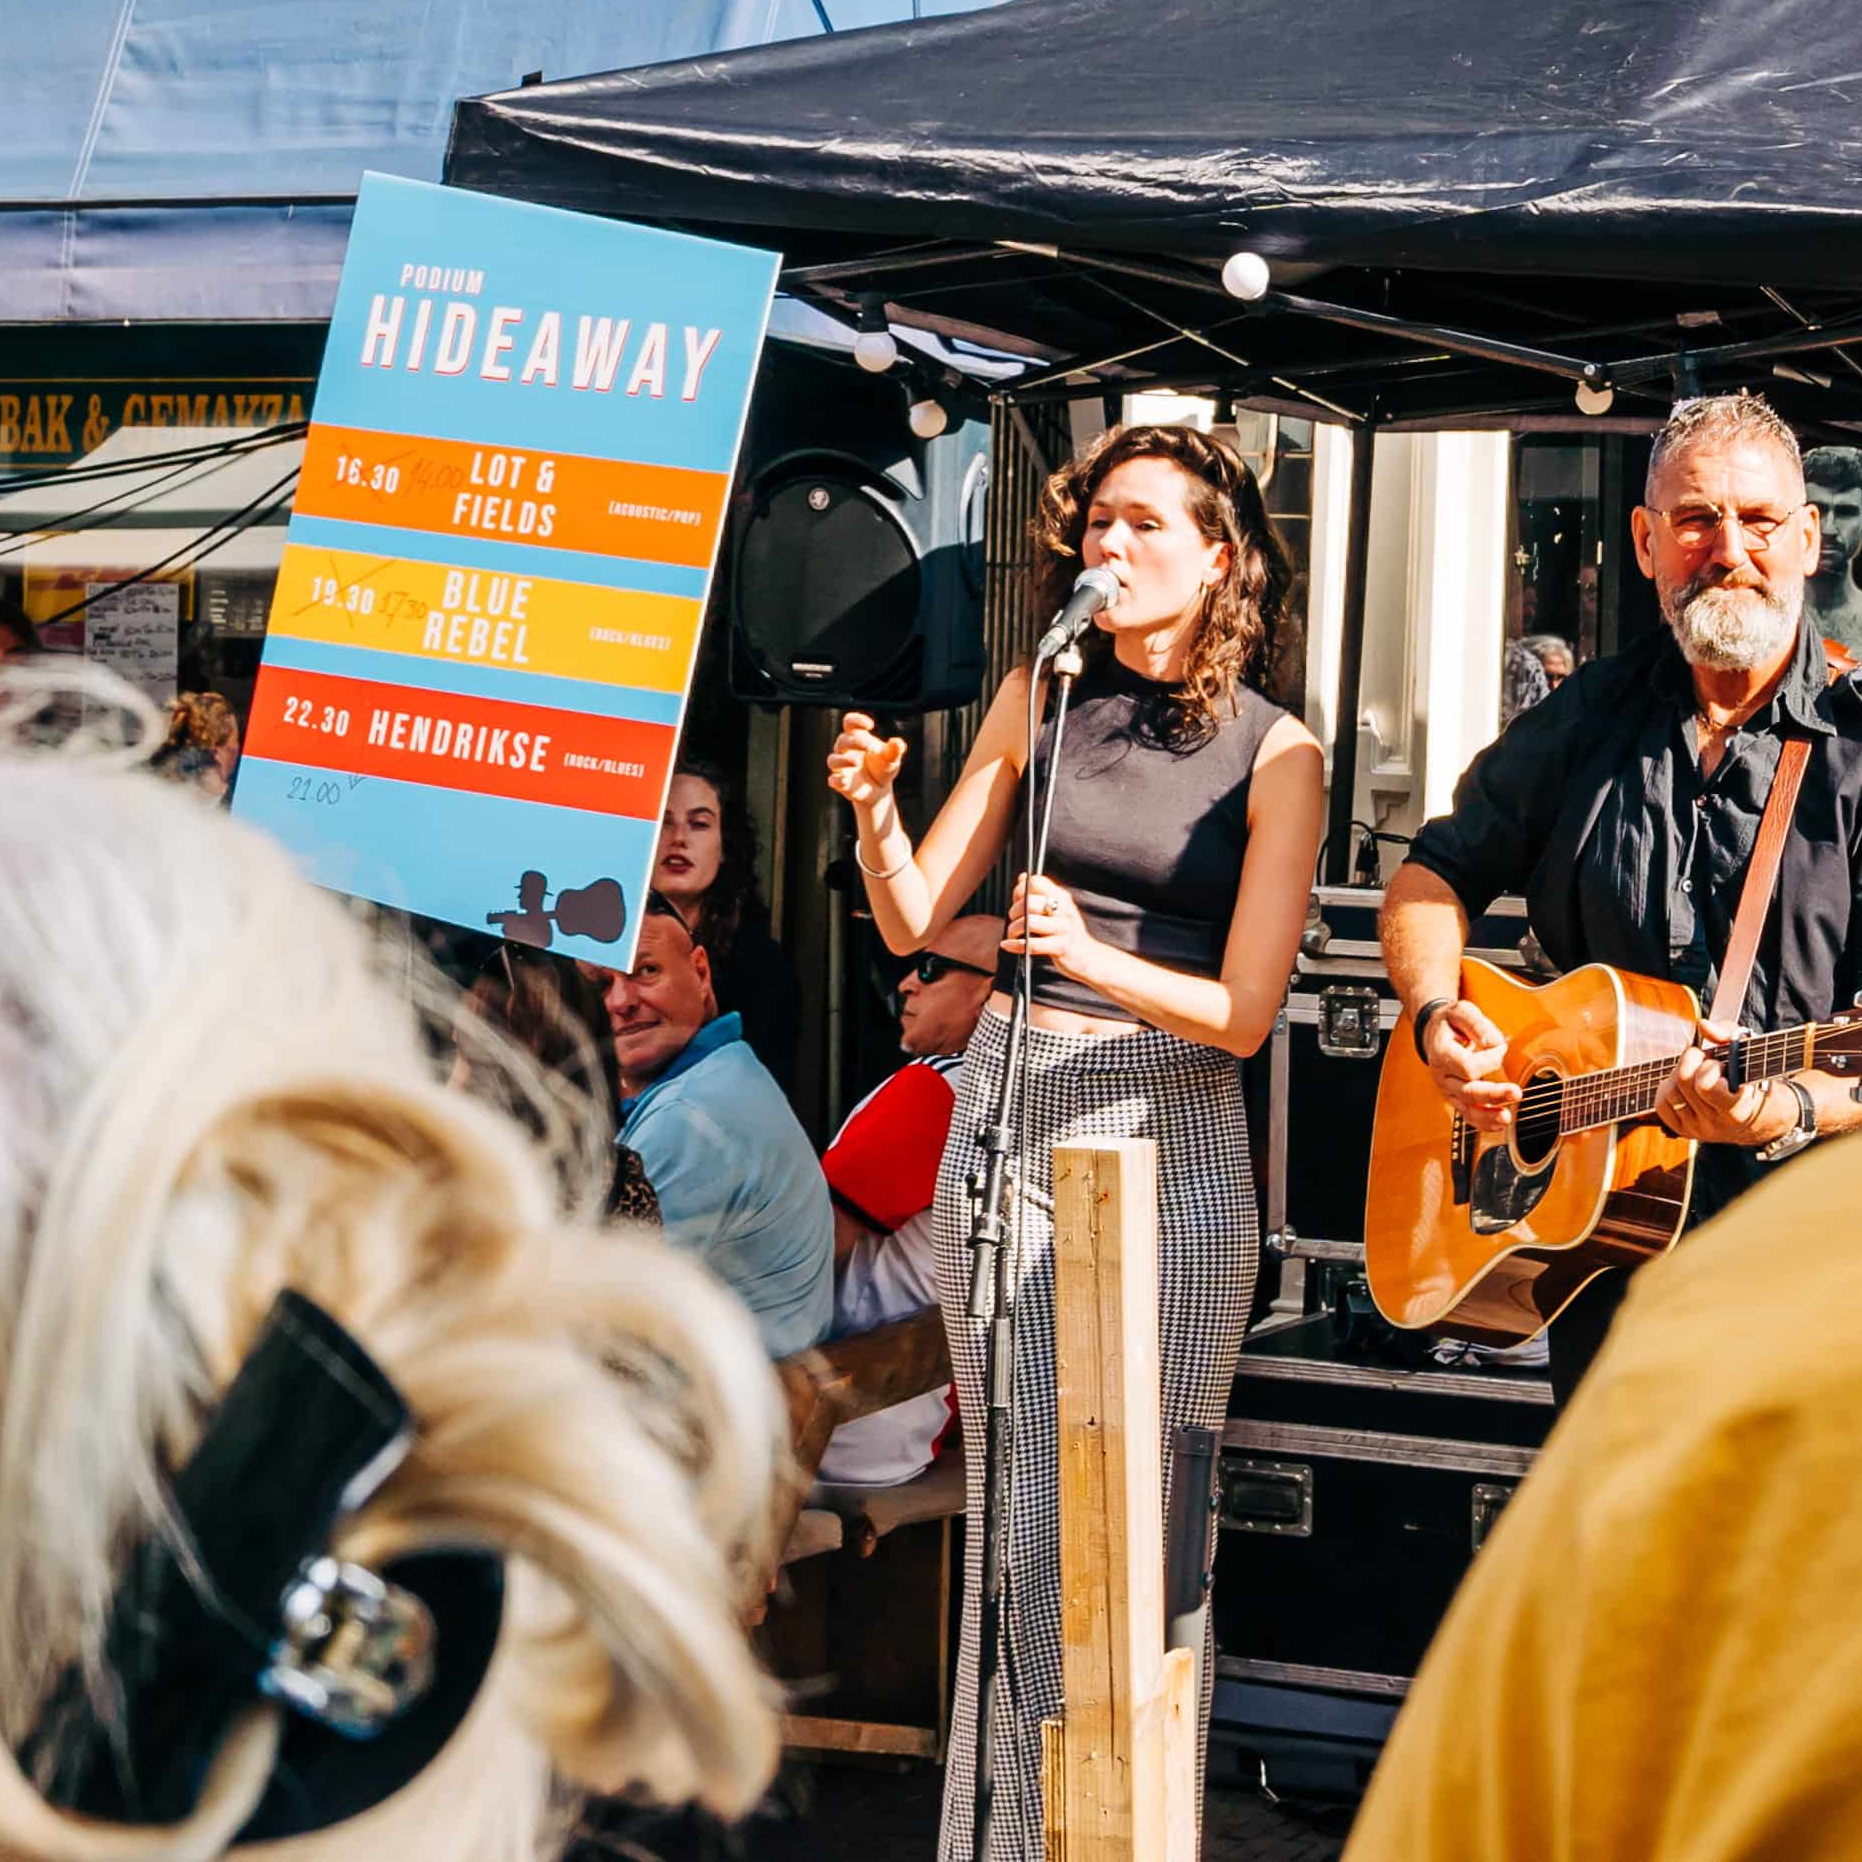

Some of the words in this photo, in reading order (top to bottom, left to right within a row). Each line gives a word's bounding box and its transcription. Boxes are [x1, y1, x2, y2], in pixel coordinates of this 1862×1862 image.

[400, 263, 485, 295] PODIUM
[361, 294, 723, 402] HIDEAWAY
[336, 454, 401, 495] 16.30
[470, 450, 527, 490] LOT
[536, 459, 556, 494] &
[452, 490, 557, 539] FIELDS
[311, 575, 376, 616] 19.30
[441, 569, 533, 620] BLUE
[422, 610, 531, 664] REBEL
[282, 695, 350, 737] 22.30
[366, 707, 552, 773] HENDRIKSE
